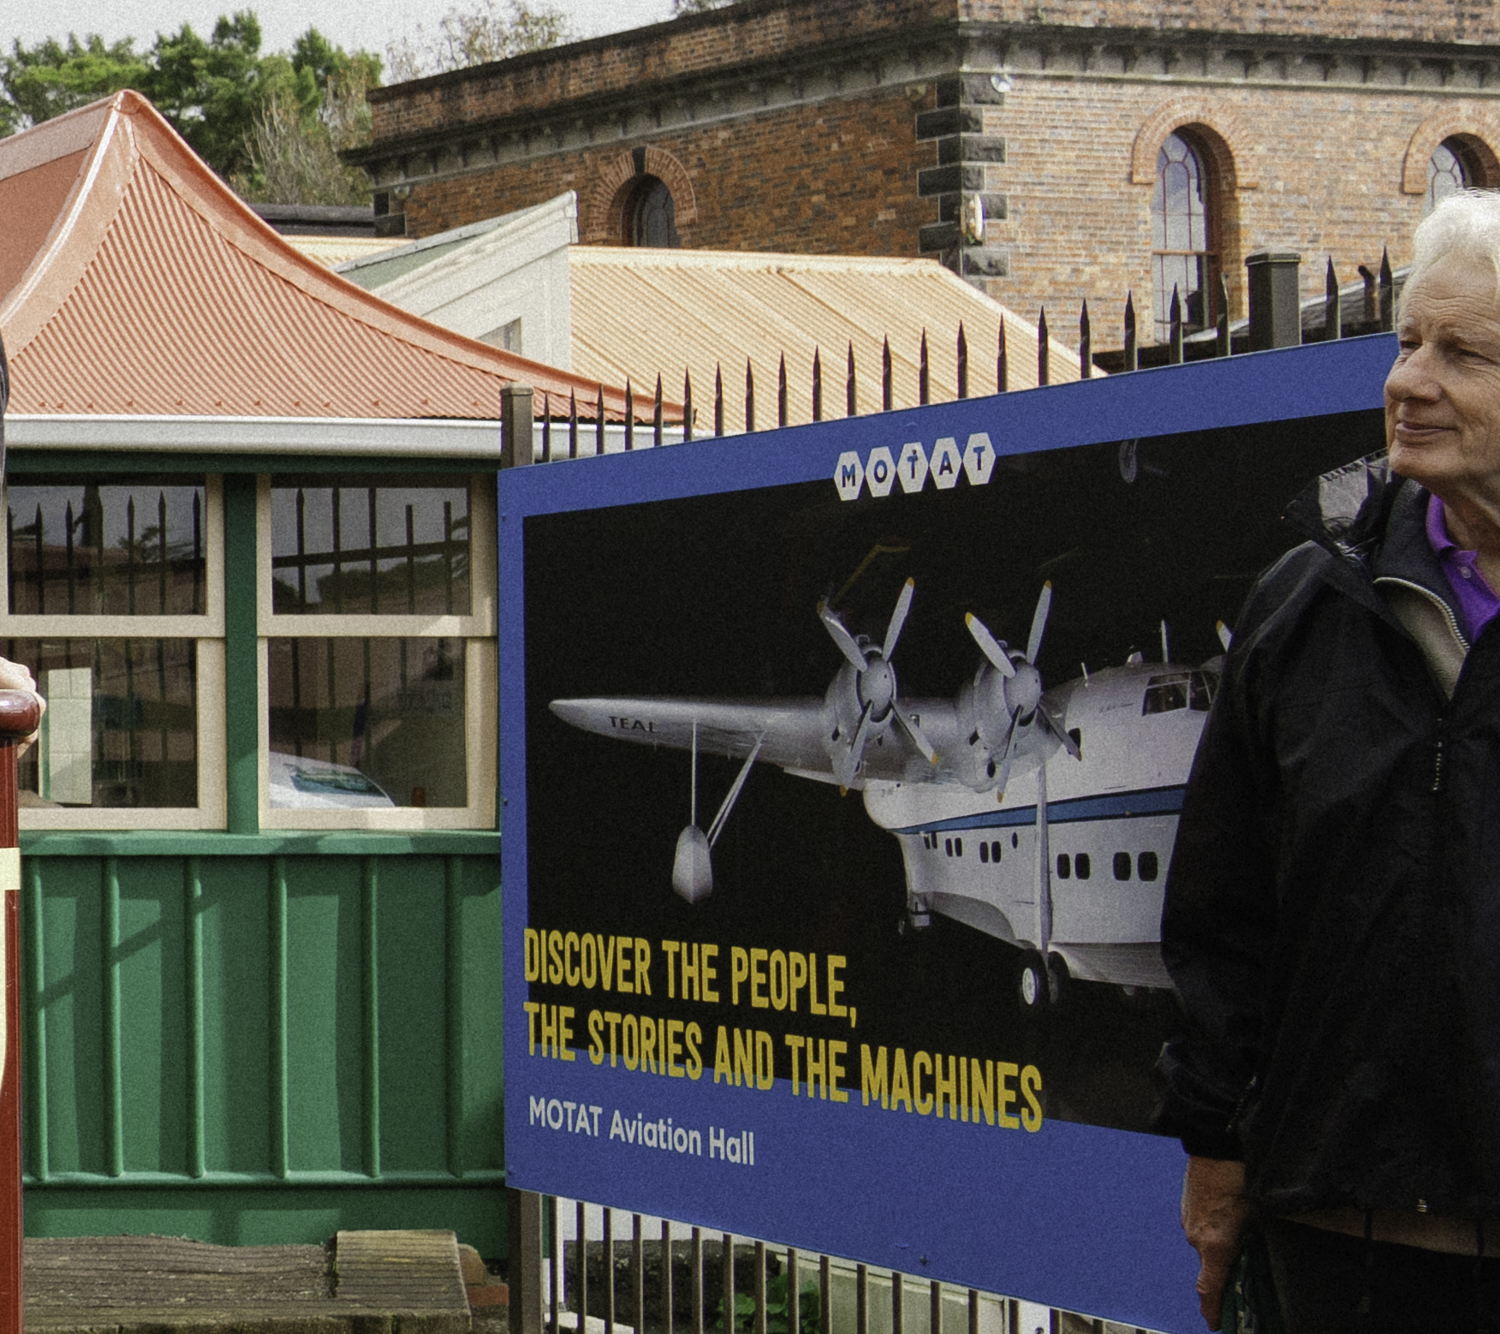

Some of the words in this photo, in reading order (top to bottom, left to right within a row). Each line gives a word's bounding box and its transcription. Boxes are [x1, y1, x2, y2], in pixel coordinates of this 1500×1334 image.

[838, 439, 990, 495] MOTAT
[608, 716, 657, 733] TEAL
[524, 928, 651, 996] DISCOVER
[662, 940, 719, 1003] THE
[731, 946, 857, 1028] PEOPLE,
[524, 1002, 576, 1061] THE
[588, 1010, 702, 1080] STORIES
[714, 1025, 774, 1091] AND
[785, 1034, 849, 1103] THE
[861, 1044, 1043, 1133] MACHINES
[529, 1096, 603, 1137] MOTAT
[609, 1109, 702, 1156] Aviation
[709, 1126, 754, 1166] Hall
